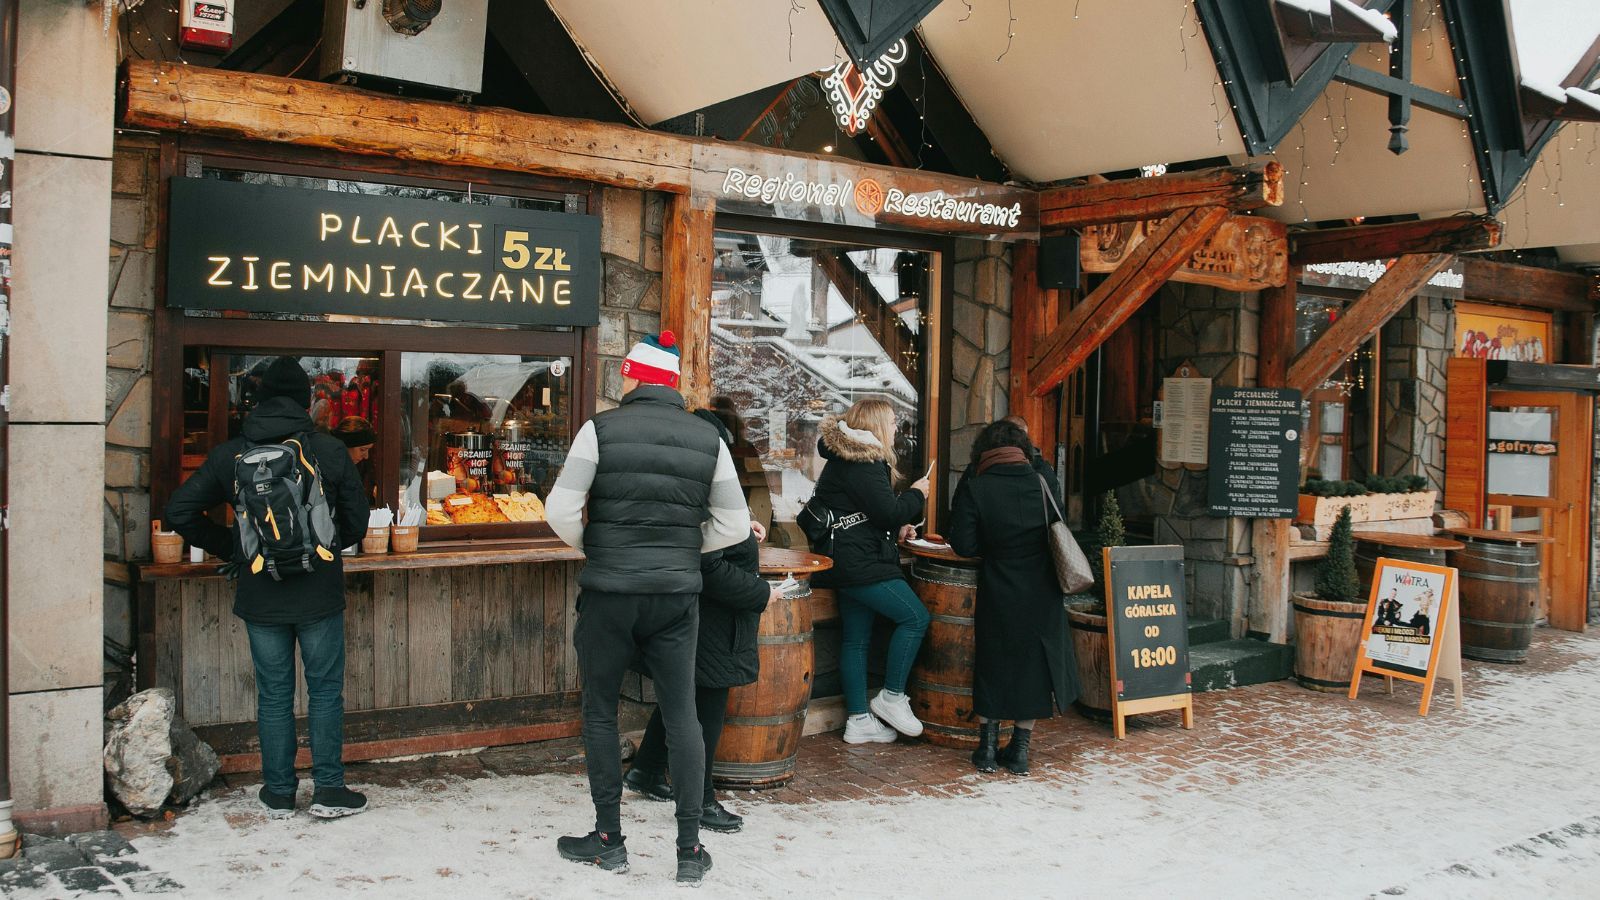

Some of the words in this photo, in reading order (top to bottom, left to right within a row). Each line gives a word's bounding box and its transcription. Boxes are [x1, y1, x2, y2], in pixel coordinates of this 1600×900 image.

[722, 167, 852, 207] Regional
[884, 188, 1022, 227] Restaurant
[320, 212, 483, 255] PLACKI
[207, 256, 571, 305] ZIEMNIACZANE
[457, 450, 492, 459] GRZANIEC
[507, 452, 523, 460] HOT
[471, 459, 487, 467] HOT
[505, 460, 524, 468] WINE
[469, 467, 487, 475] WINE
[1127, 584, 1172, 600] KAPELA
[1124, 603, 1177, 618] GÓRALSKA
[1144, 625, 1160, 638] OD
[1130, 645, 1177, 668] 18:00
